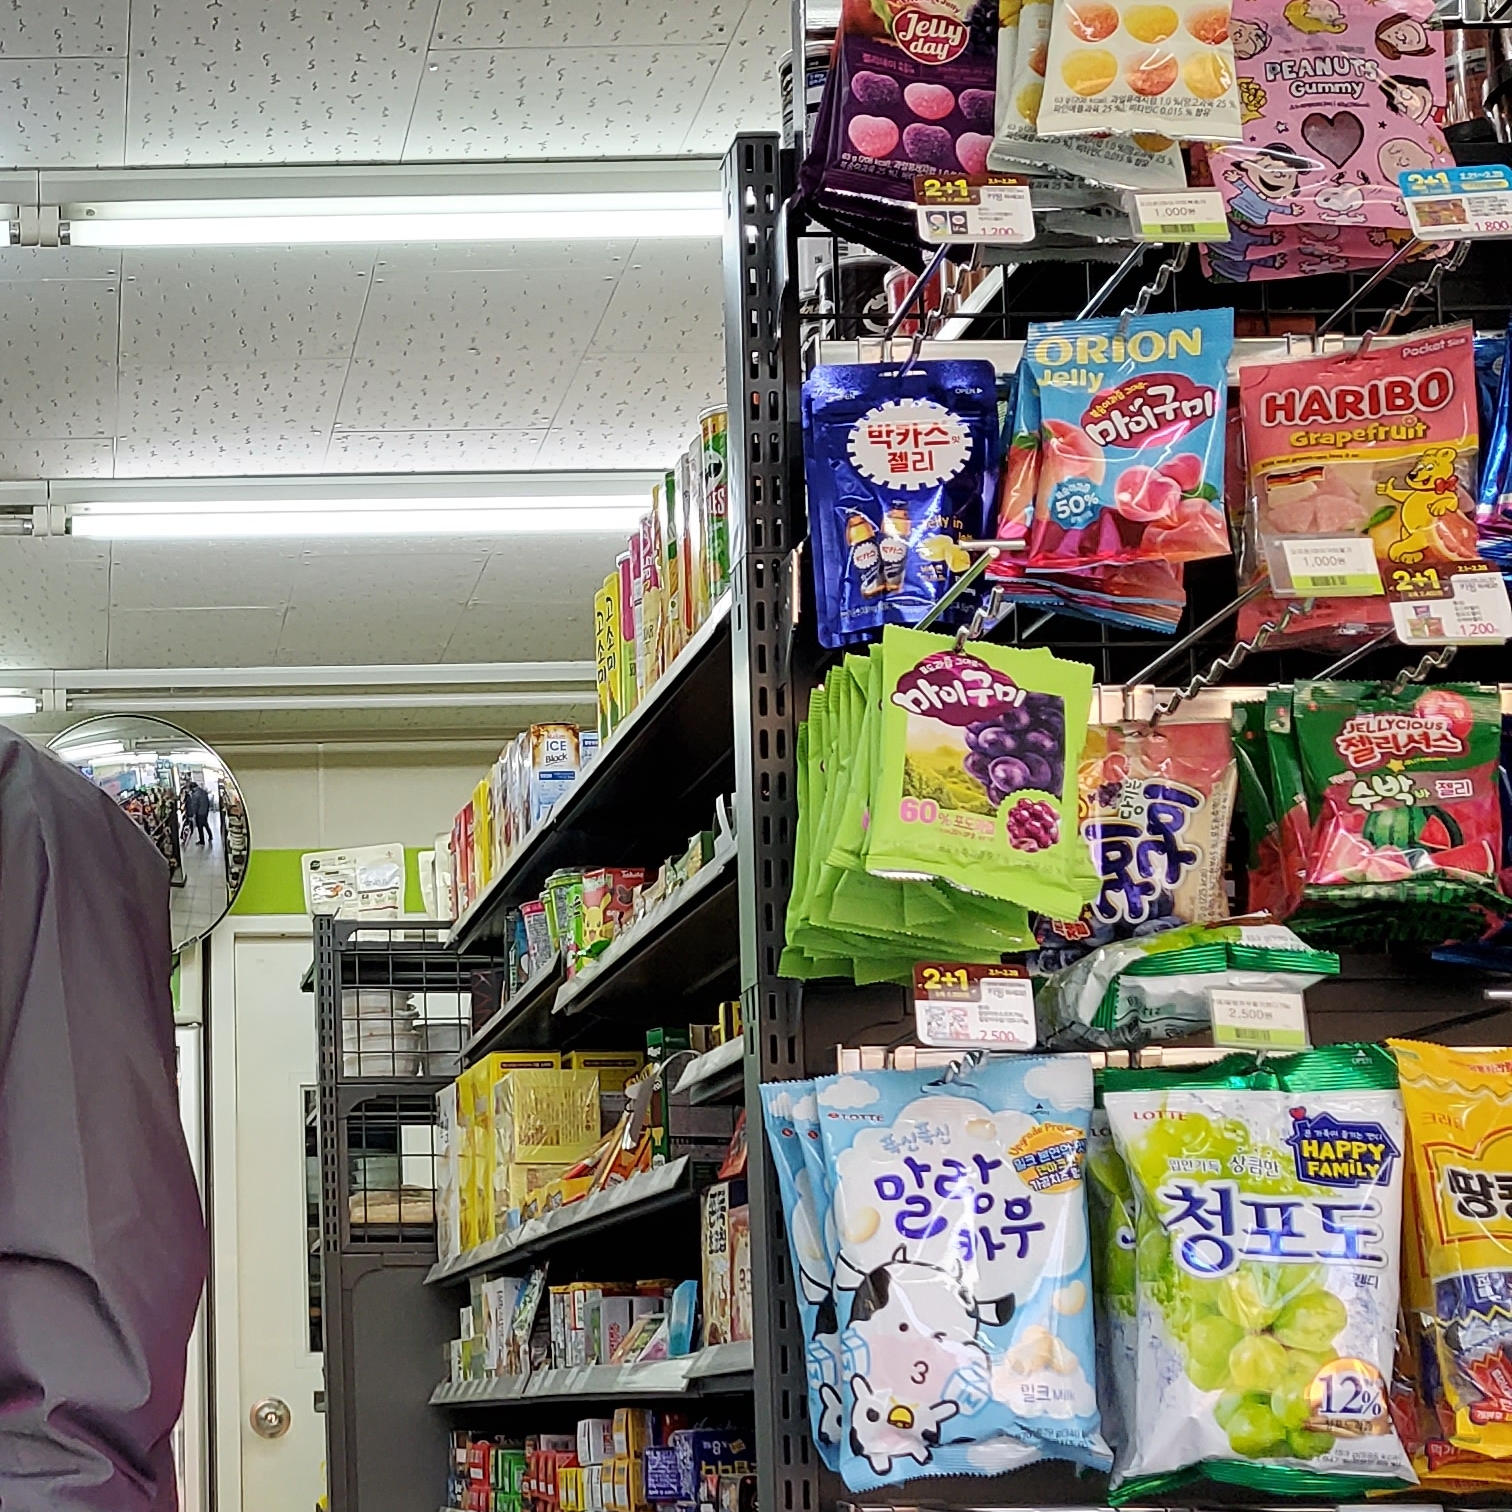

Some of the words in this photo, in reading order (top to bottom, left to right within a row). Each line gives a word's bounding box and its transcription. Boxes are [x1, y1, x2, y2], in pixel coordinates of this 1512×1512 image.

[898, 13, 963, 46] Jelly
[909, 34, 950, 60] day
[1265, 57, 1379, 82] PEANUTS
[1289, 80, 1364, 99] Gummy
[924, 178, 969, 198] 2+1
[1407, 172, 1449, 191] 2+1
[1154, 207, 1195, 217] 1,000원
[1035, 328, 1202, 366] ORION
[1402, 341, 1445, 358] Pocket
[955, 387, 976, 395] OPEN
[1037, 368, 1104, 394] Jelly
[1263, 369, 1450, 426] HARIBO
[1086, 384, 1214, 446] 마이구미
[867, 423, 951, 449] 박카스
[1289, 420, 1428, 449] Grapefruit
[887, 450, 935, 474] 젤리
[1055, 493, 1099, 519] 50%
[953, 516, 963, 530] in
[1304, 556, 1345, 567] 1,000원
[1392, 568, 1441, 592] 2+1
[606, 596, 616, 670] 고소미
[1460, 623, 1494, 637] 1,200
[595, 610, 607, 683] 고소미
[893, 671, 1027, 714] 마이구미
[1347, 718, 1443, 733] JELLYCIOUS
[546, 740, 567, 752] ICE
[1340, 733, 1459, 765] 젤리셔스
[1119, 778, 1144, 820] 당기는
[1349, 775, 1414, 809] 수박
[1438, 781, 1469, 797] 젤리
[900, 798, 937, 823] 60
[923, 967, 969, 992] 2+1
[1228, 1008, 1273, 1020] 2,500원
[979, 1030, 1015, 1042] 2,500
[1351, 1057, 1372, 1065] OPEN
[841, 1113, 884, 1123] LOTTE
[1133, 1110, 1187, 1121] LOTTE
[1301, 1140, 1385, 1160] HAPPY
[1230, 1156, 1279, 1177] 상큼한
[1163, 1184, 1384, 1274] 청포도
[1021, 1384, 1051, 1402] 밀크
[1053, 1389, 1075, 1400] Milk
[1319, 1374, 1382, 1417] 12%
